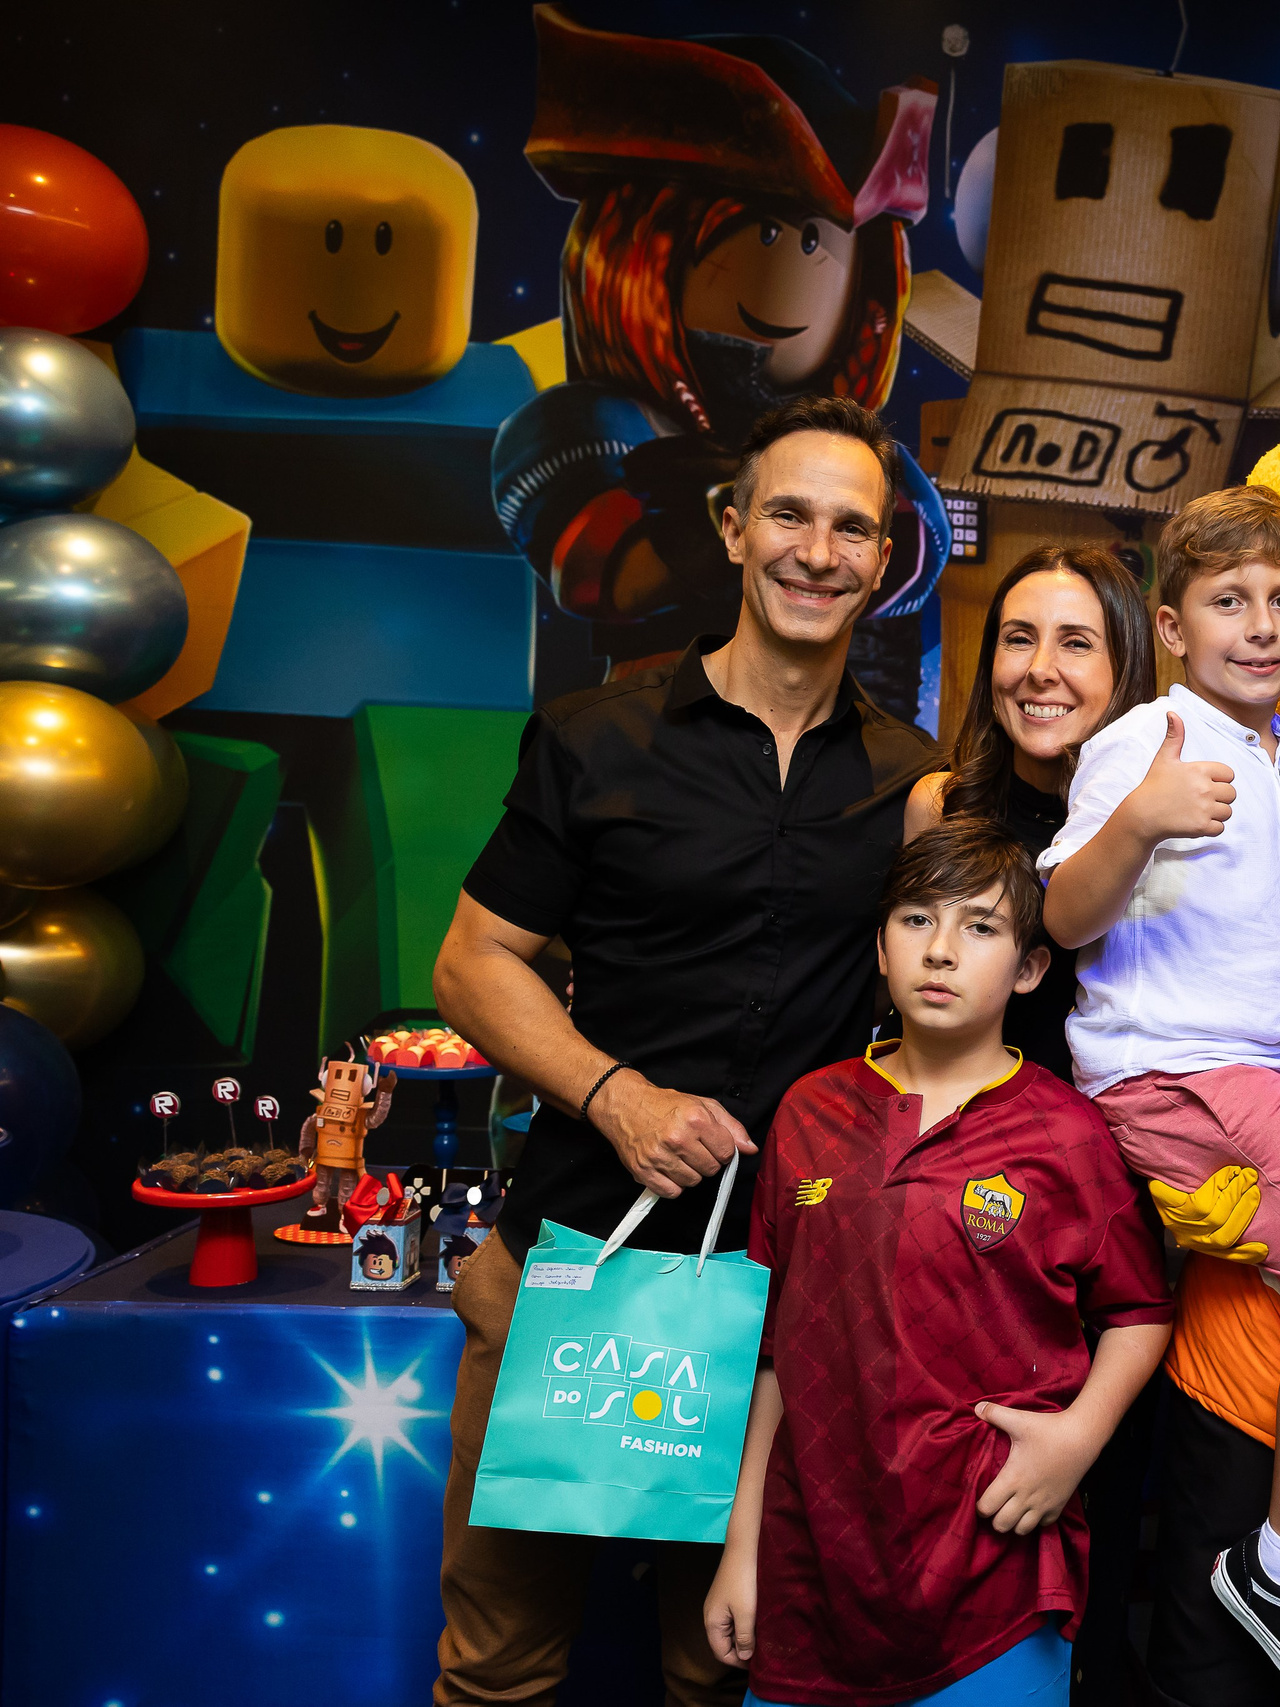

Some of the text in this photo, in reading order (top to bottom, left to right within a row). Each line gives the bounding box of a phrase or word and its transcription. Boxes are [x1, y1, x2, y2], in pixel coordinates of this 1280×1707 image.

[217, 1081, 235, 1100] R
[154, 1096, 174, 1114] R
[257, 1100, 274, 1118] R
[967, 1213, 1006, 1235] ROMA
[976, 1232, 992, 1242] 1927
[553, 1337, 698, 1389] CASA
[553, 1390, 700, 1426] DO SOL
[620, 1435, 702, 1458] FASHION
